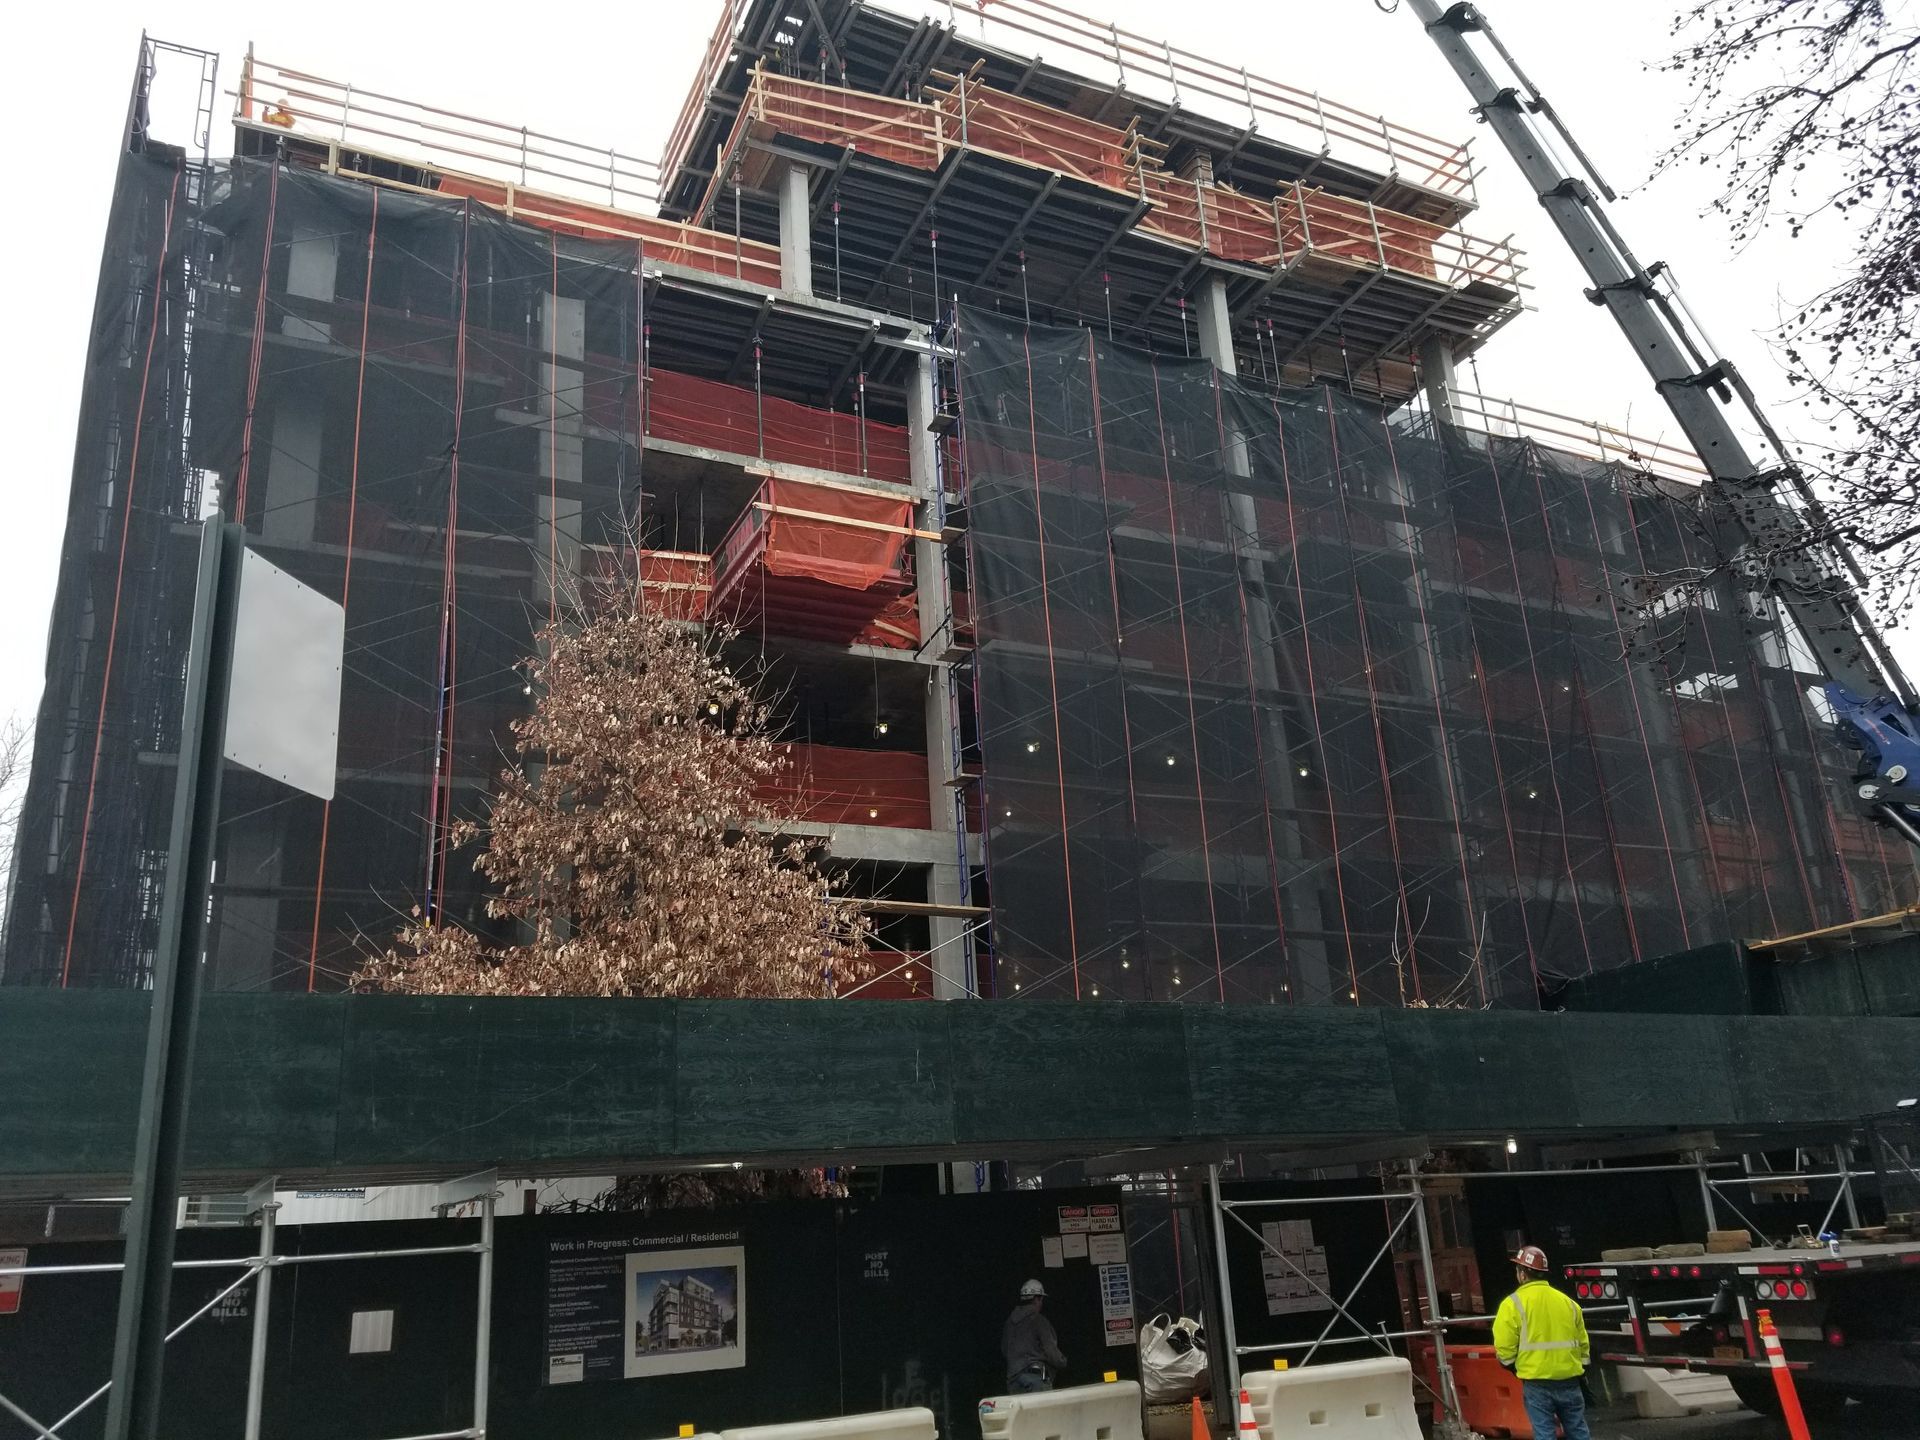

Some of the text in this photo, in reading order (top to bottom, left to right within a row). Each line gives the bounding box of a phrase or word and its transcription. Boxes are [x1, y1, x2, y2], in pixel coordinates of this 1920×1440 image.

[550, 1242, 574, 1251] Work
[576, 1240, 585, 1249] in
[587, 1239, 630, 1250] Progress:
[632, 1234, 684, 1246] Commercial
[690, 1231, 739, 1243] Residencial
[865, 1252, 889, 1260] POST
[870, 1261, 883, 1269] NO
[864, 1269, 889, 1278] BILLS
[222, 1298, 241, 1307] NO
[211, 1307, 249, 1317] BILLS
